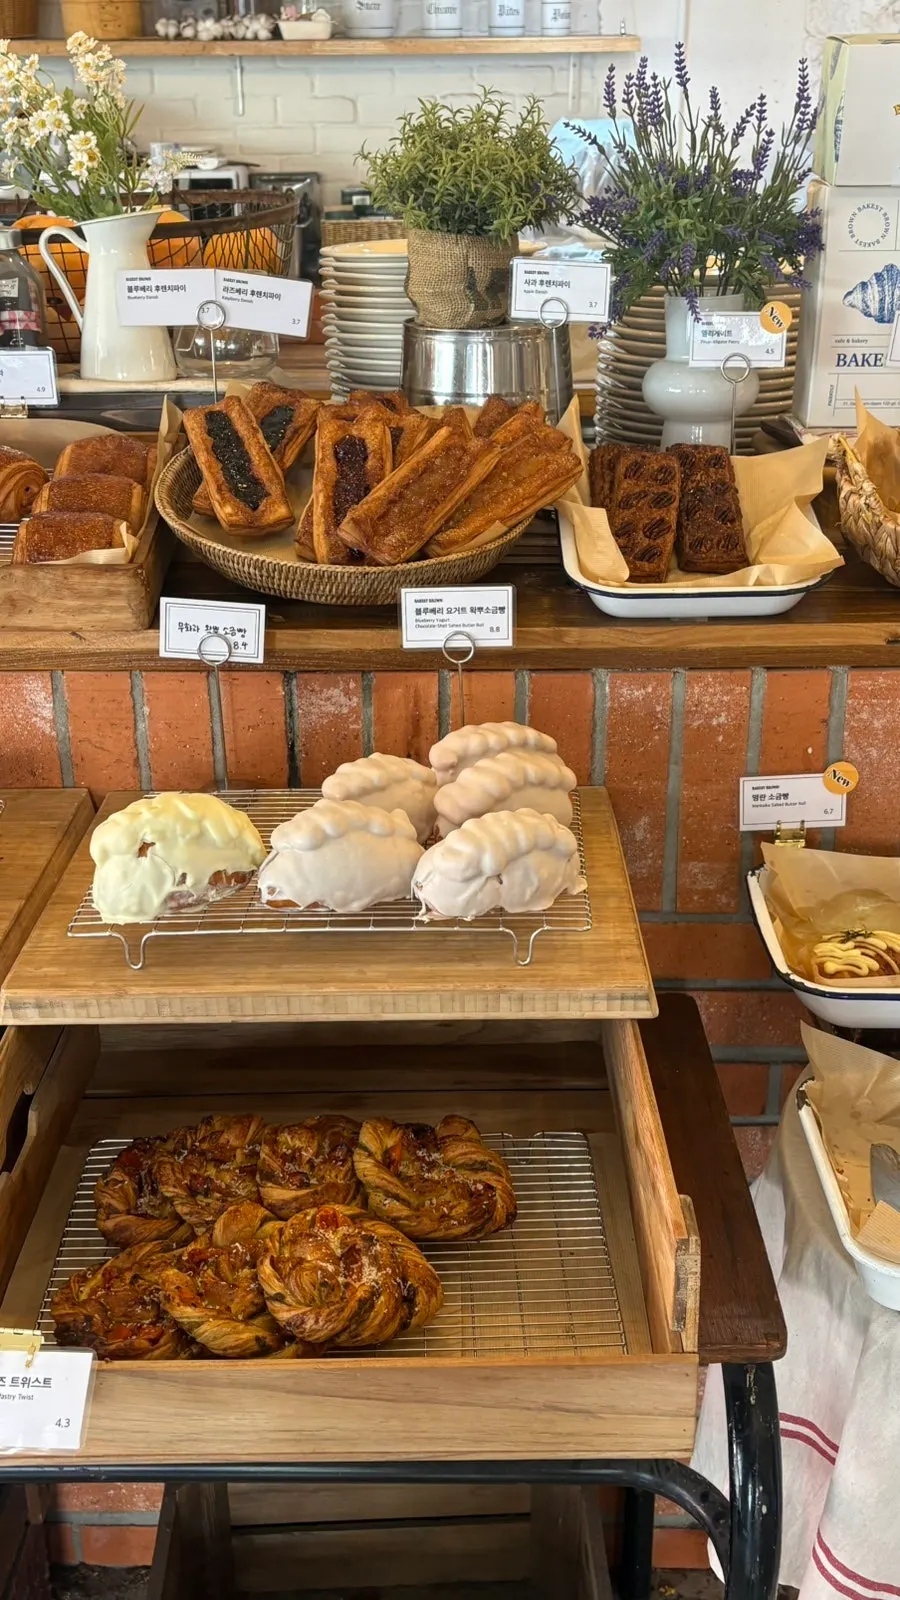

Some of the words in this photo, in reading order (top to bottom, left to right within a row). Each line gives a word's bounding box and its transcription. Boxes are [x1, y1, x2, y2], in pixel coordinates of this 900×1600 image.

[127, 285, 153, 293] 블루베리
[154, 284, 186, 293] 후렌치파이
[524, 279, 537, 287] 사과
[539, 279, 571, 288] 후렌치파이
[222, 285, 248, 296] 라즈베리
[250, 289, 282, 300] 후렌치파이
[765, 306, 784, 328] New
[415, 607, 444, 616] 블루베리
[446, 606, 468, 615] 요거트
[177, 621, 200, 633] 무화과
[233, 641, 248, 651] 8.4
[827, 768, 851, 788] New
[752, 793, 767, 802] 명란
[768, 792, 789, 801] 소금빵
[9, 1376, 53, 1388] 트위스트
[18, 1393, 34, 1401] Twist
[55, 1418, 71, 1428] 4.3
